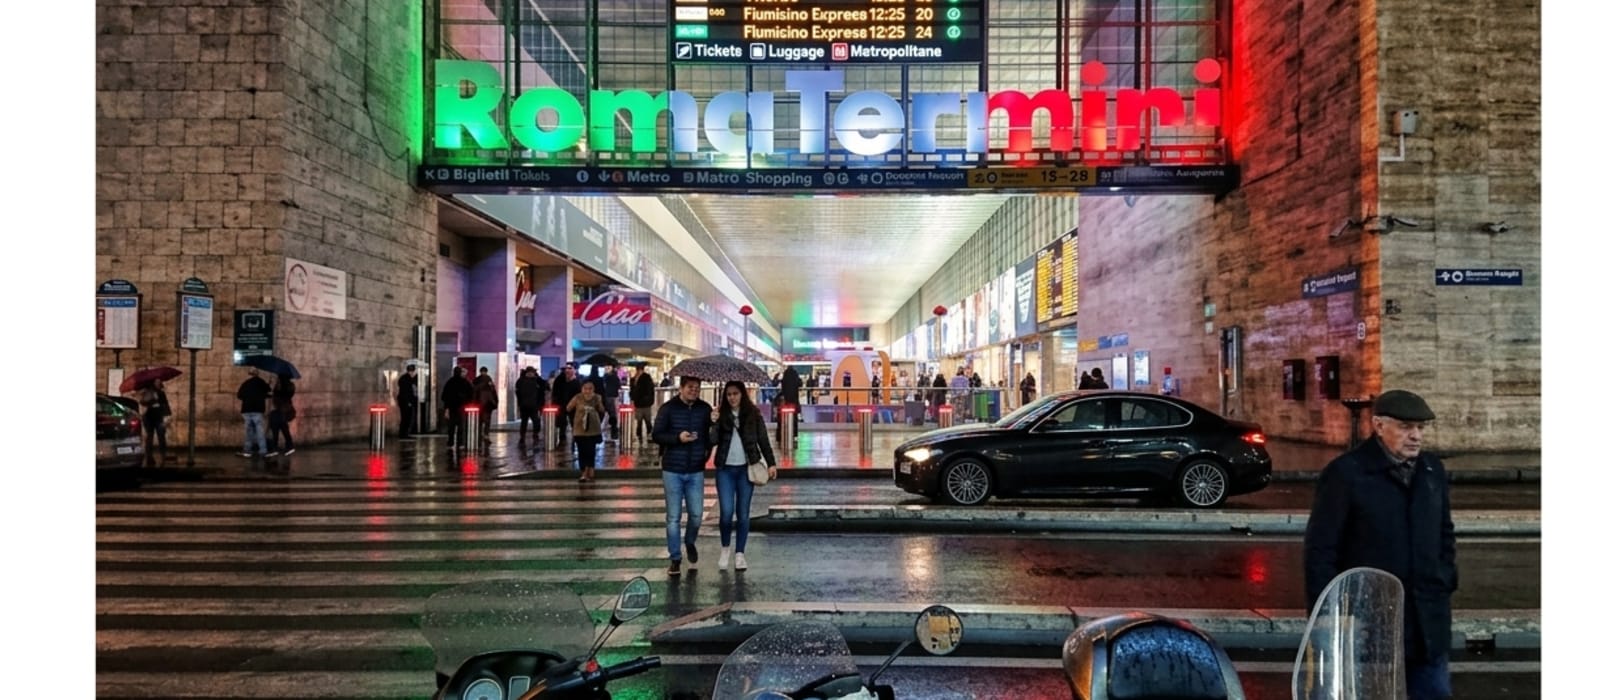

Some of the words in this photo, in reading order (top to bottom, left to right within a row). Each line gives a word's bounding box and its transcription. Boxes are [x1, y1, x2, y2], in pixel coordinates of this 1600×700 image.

[869, 7, 906, 20] 12:25
[915, 7, 933, 20] 20
[869, 25, 906, 38] 12:25
[915, 25, 933, 38] 24
[694, 44, 743, 57] Tickets
[769, 44, 825, 60] Luggage
[435, 58, 1221, 156] RomaTermini
[627, 171, 670, 182] Metro
[745, 171, 813, 186] Shopping
[580, 290, 651, 328] Ciao
